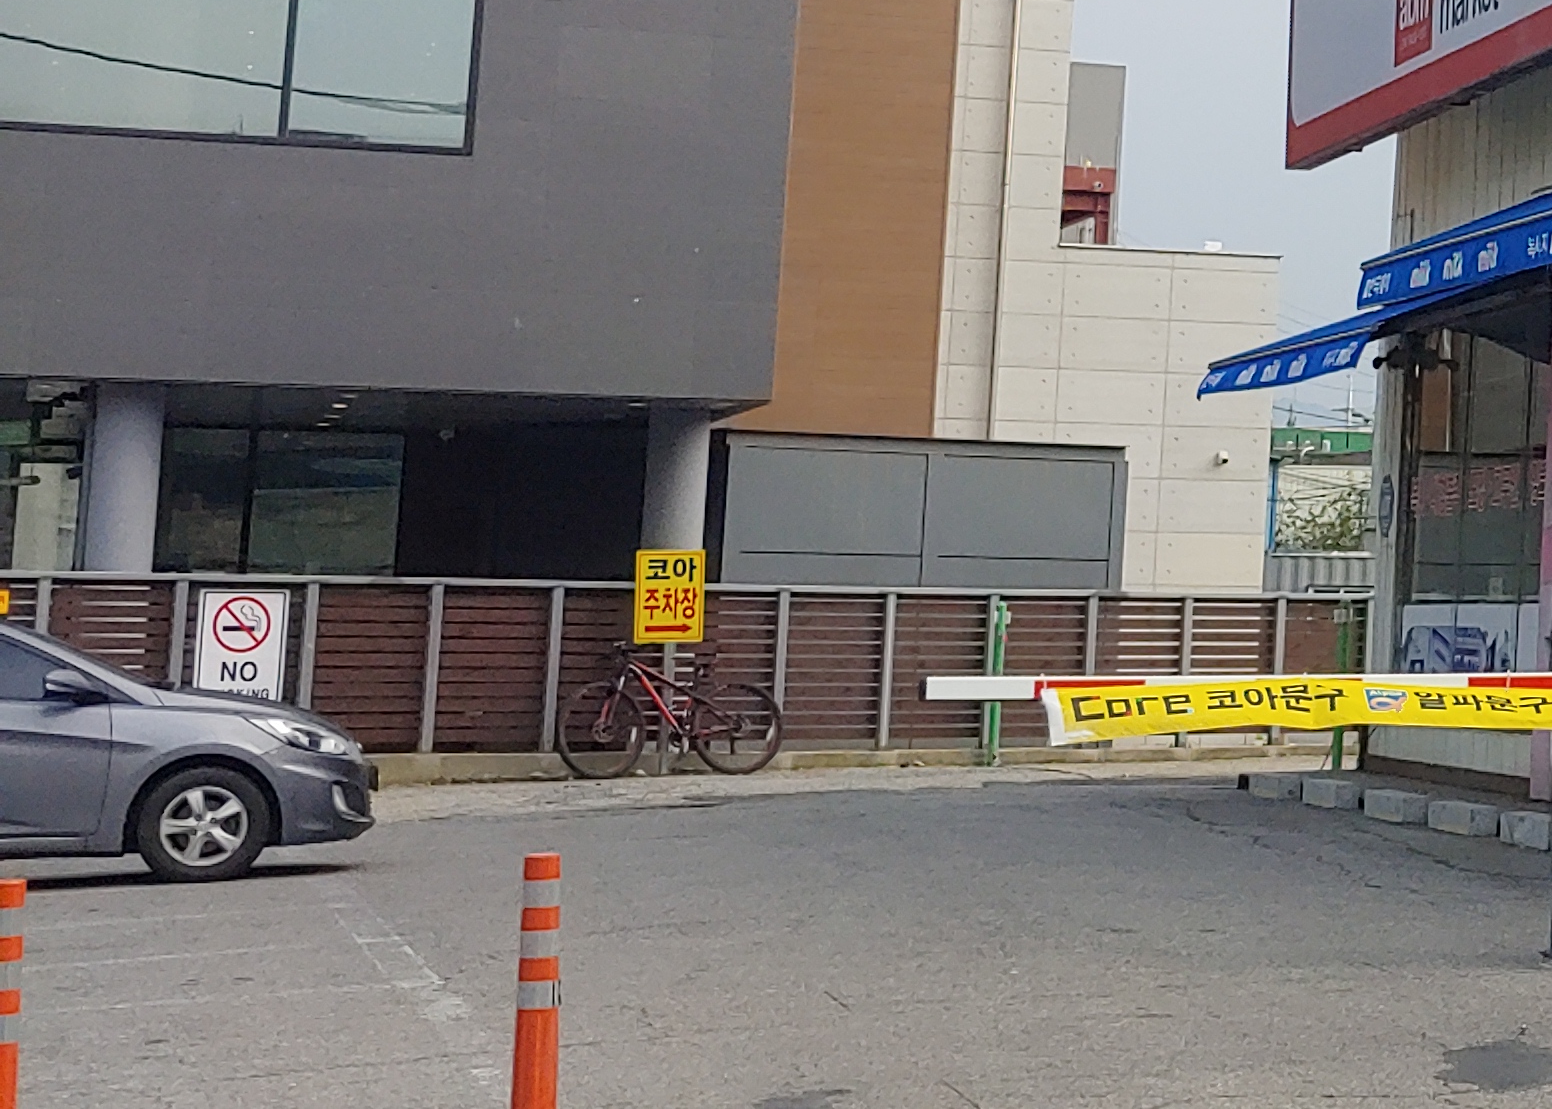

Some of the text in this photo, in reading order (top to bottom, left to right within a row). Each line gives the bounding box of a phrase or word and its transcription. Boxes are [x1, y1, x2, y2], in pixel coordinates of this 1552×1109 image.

[645, 557, 698, 583] 코아
[644, 586, 698, 622] 주차장
[220, 661, 258, 682] NO
[1071, 694, 1192, 722] Core
[1207, 684, 1348, 712] 코아문구
[1414, 691, 1552, 712] 알파문구
